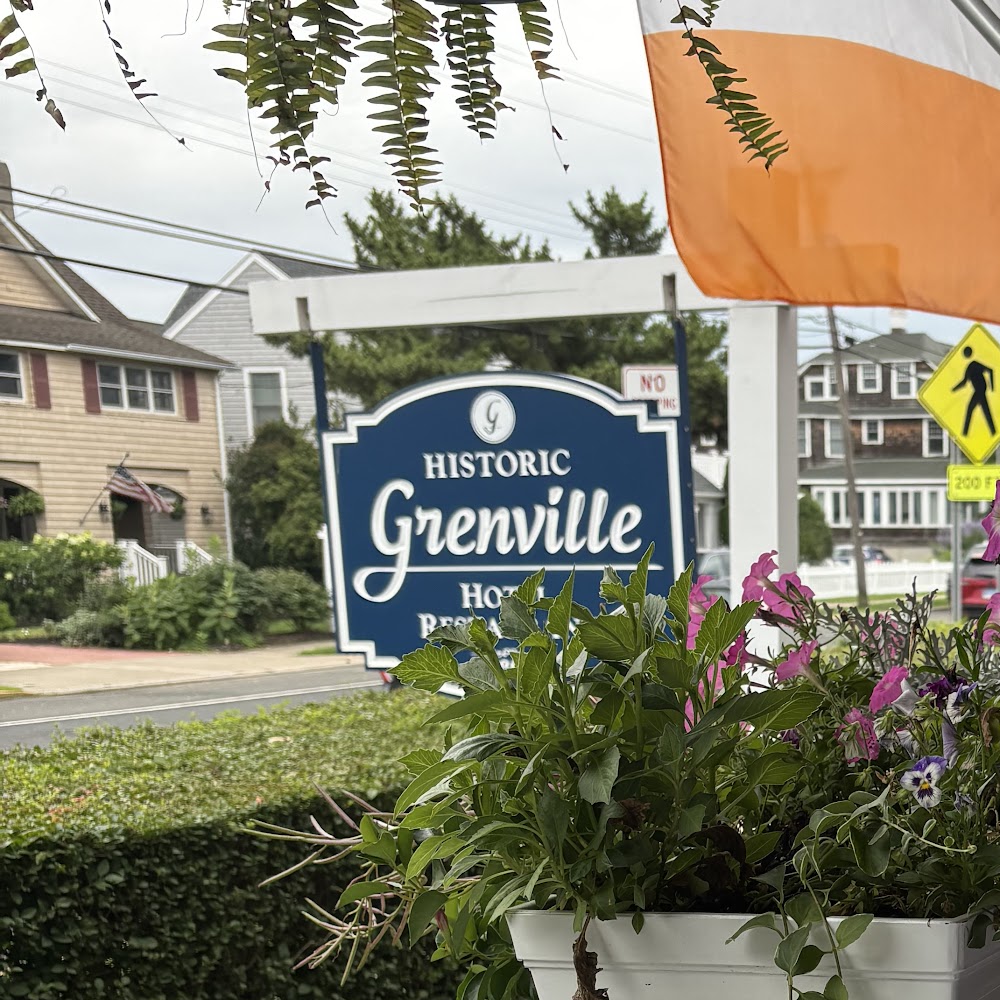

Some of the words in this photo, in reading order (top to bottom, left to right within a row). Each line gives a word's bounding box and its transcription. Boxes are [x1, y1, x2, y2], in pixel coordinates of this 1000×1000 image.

[640, 373, 666, 392] NO
[422, 448, 572, 479] HISTORIC
[954, 475, 982, 490] 200
[352, 479, 643, 602] Grenville
